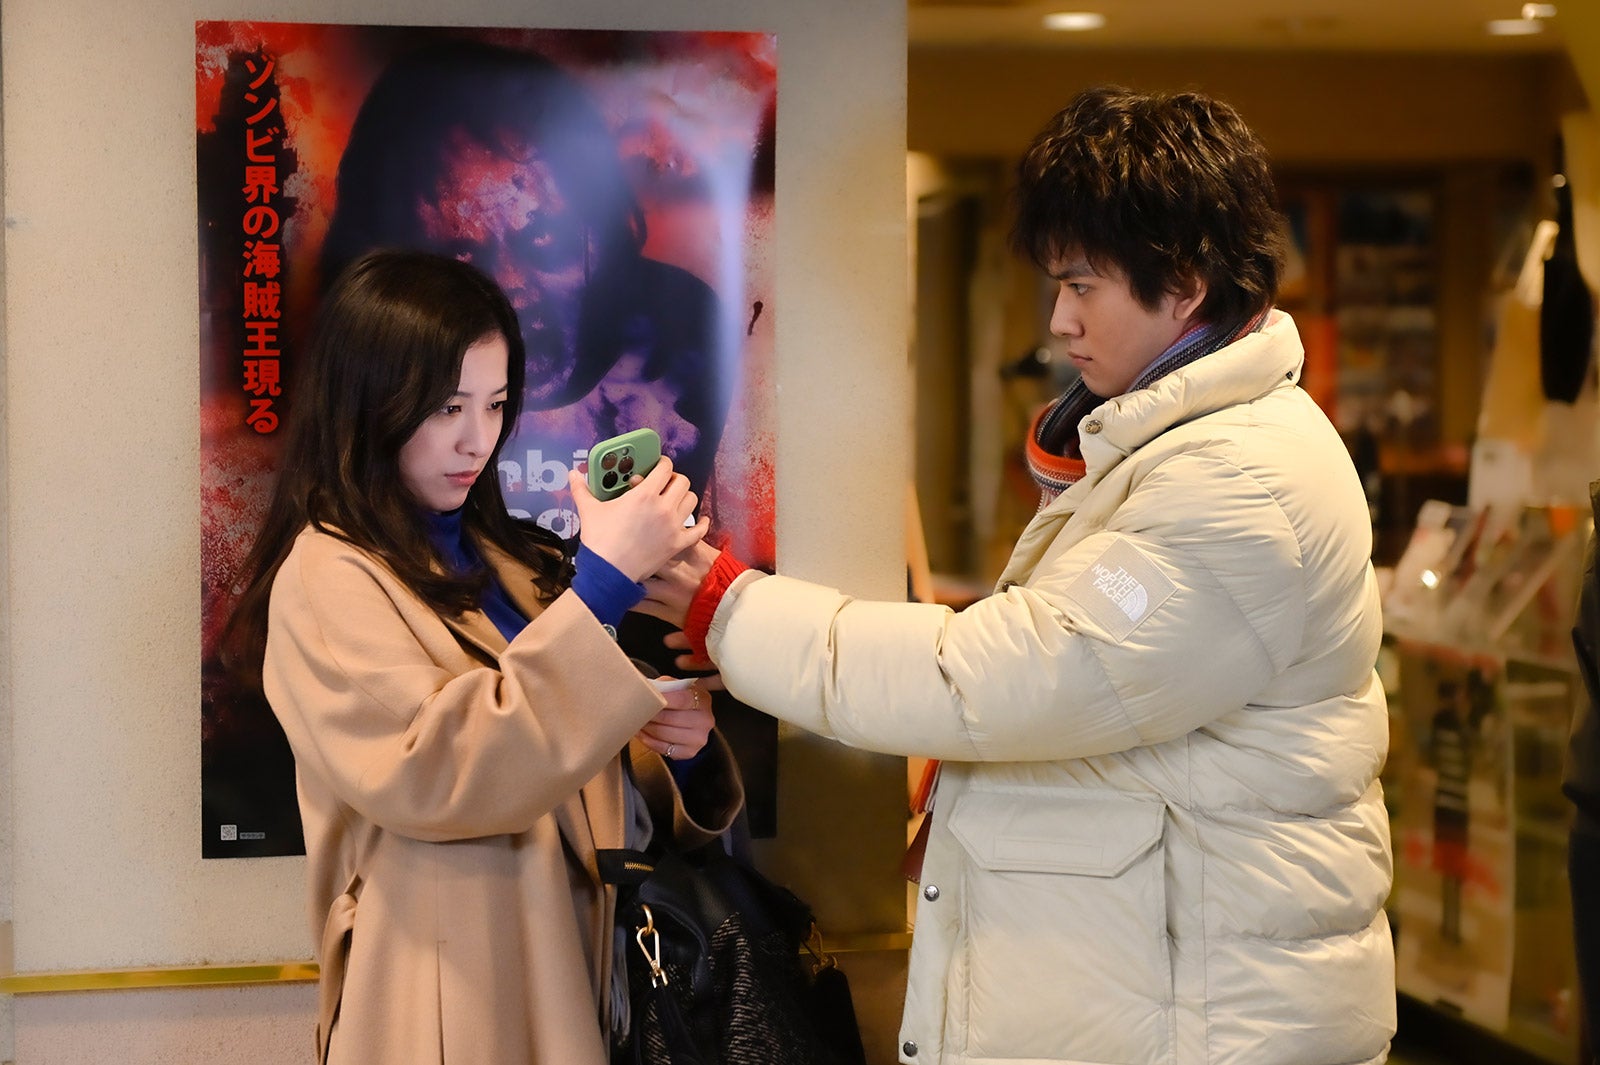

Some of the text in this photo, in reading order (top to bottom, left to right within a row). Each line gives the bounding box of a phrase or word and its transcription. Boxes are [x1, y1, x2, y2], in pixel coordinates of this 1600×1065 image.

[242, 54, 281, 435] ゾンビ界の海賊王現る
[1091, 563, 1132, 597] NORTH
[1092, 577, 1125, 604] FACE
[1114, 566, 1138, 590] THE
